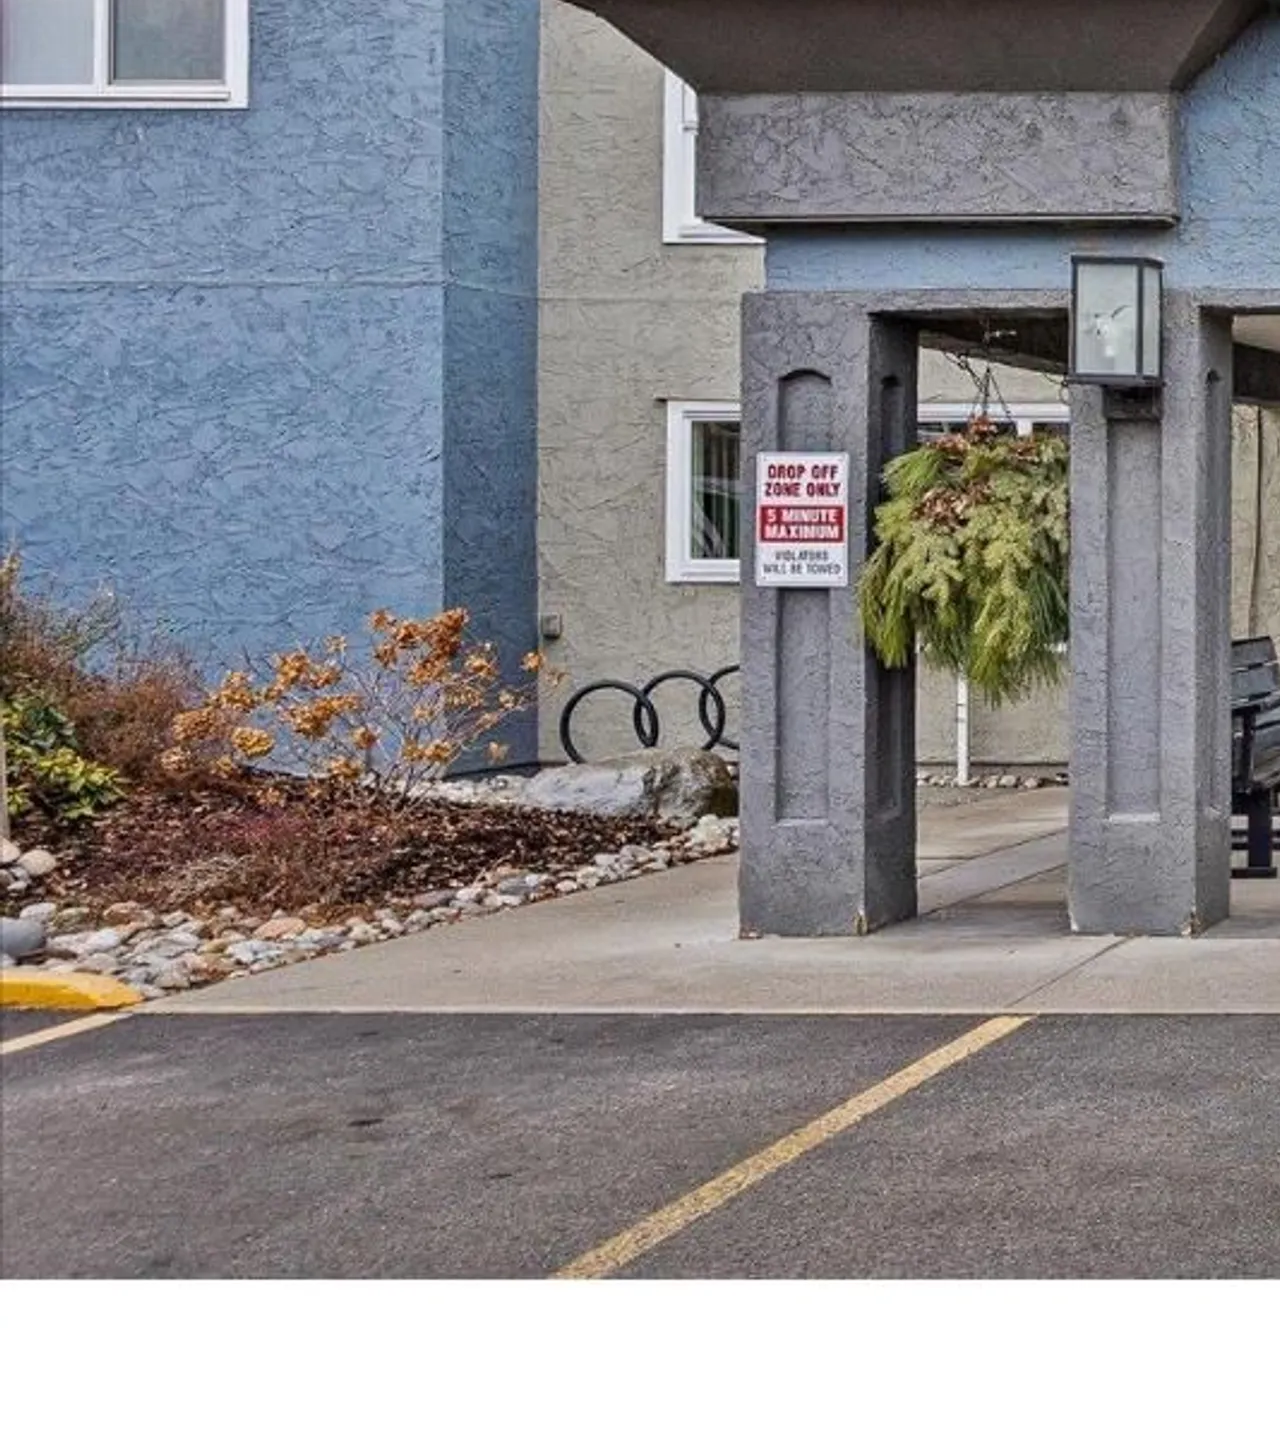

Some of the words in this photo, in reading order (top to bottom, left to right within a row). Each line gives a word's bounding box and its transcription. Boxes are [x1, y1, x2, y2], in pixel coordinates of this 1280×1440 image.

[767, 463, 806, 479] DROP
[811, 464, 839, 479] OFF
[764, 482, 802, 497] ZONE
[806, 482, 841, 497] ONLY
[766, 508, 777, 523] 5
[781, 508, 838, 523] MINUTE
[764, 523, 839, 539] MAXIMUM
